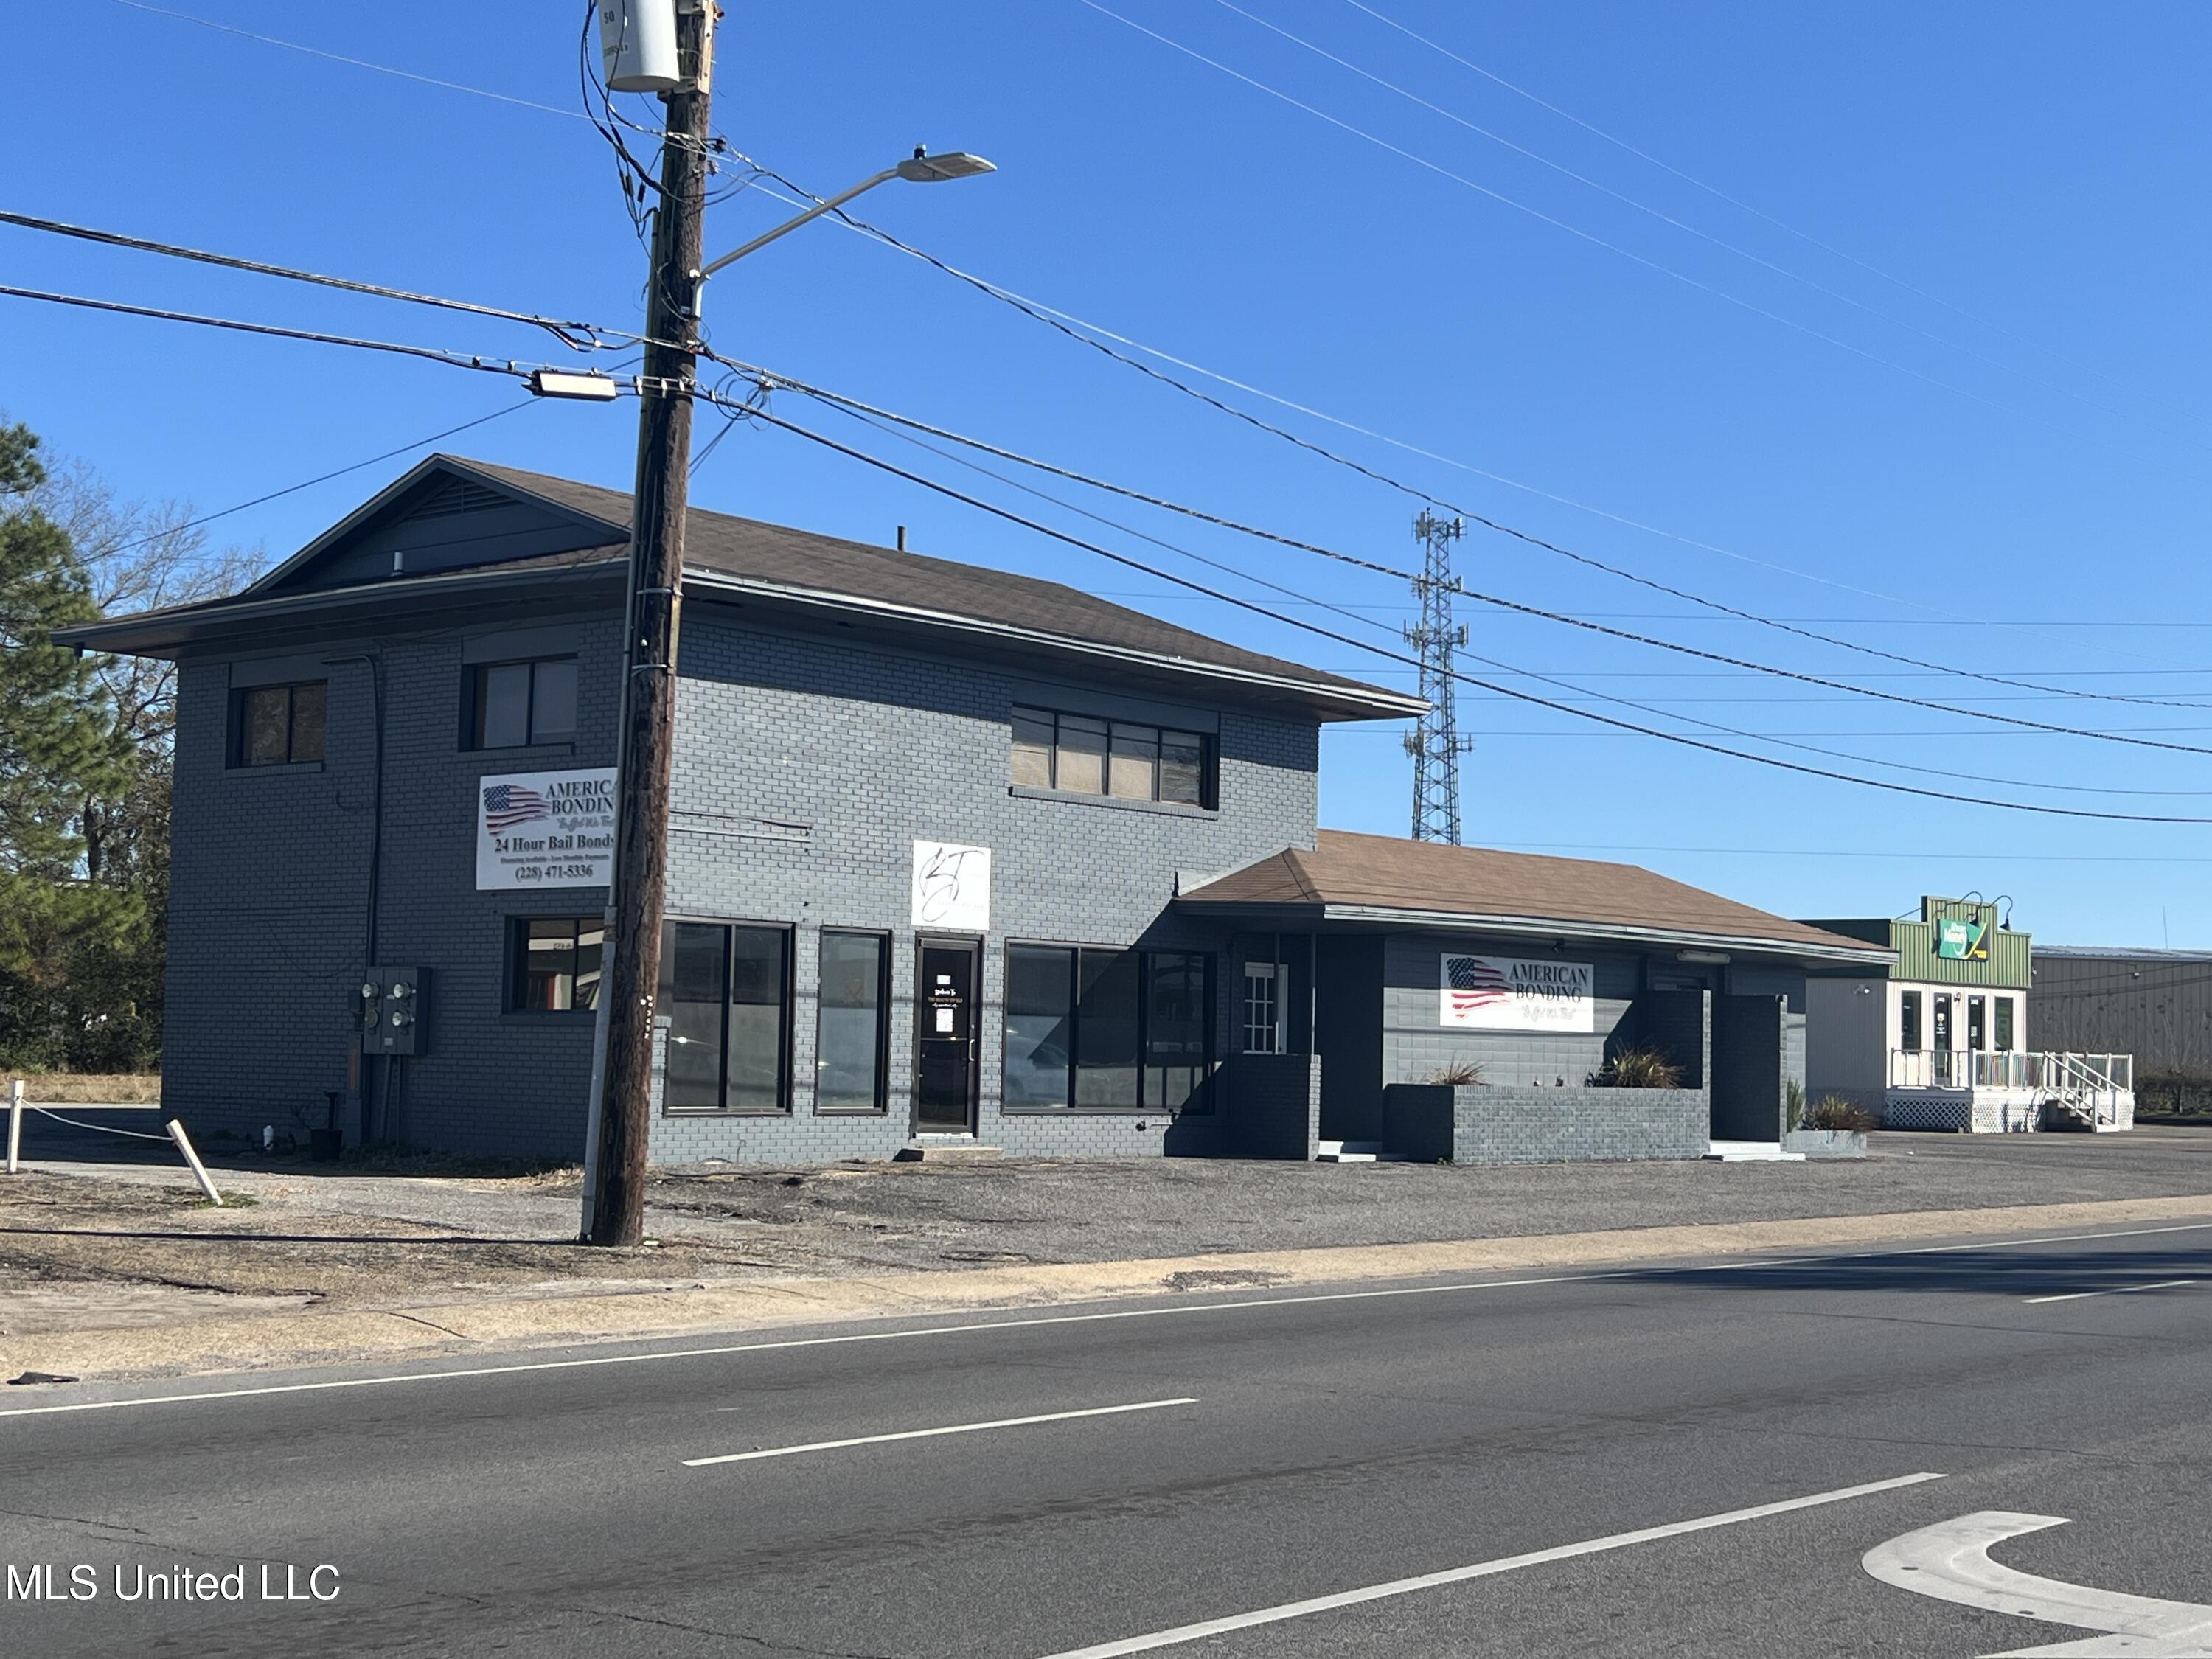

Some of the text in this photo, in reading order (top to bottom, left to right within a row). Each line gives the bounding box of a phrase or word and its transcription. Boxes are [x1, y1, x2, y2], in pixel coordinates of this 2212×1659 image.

[604, 10, 614, 24] 50
[546, 779, 618, 799] AMERIC
[552, 796, 613, 815] BONDIN
[495, 838, 509, 852] 24
[513, 838, 545, 852] Hour
[549, 835, 573, 850] Bail
[515, 864, 593, 882] (228) 471-5336
[1509, 963, 1588, 984] AMERICAN
[1516, 983, 1582, 1004] BONDING
